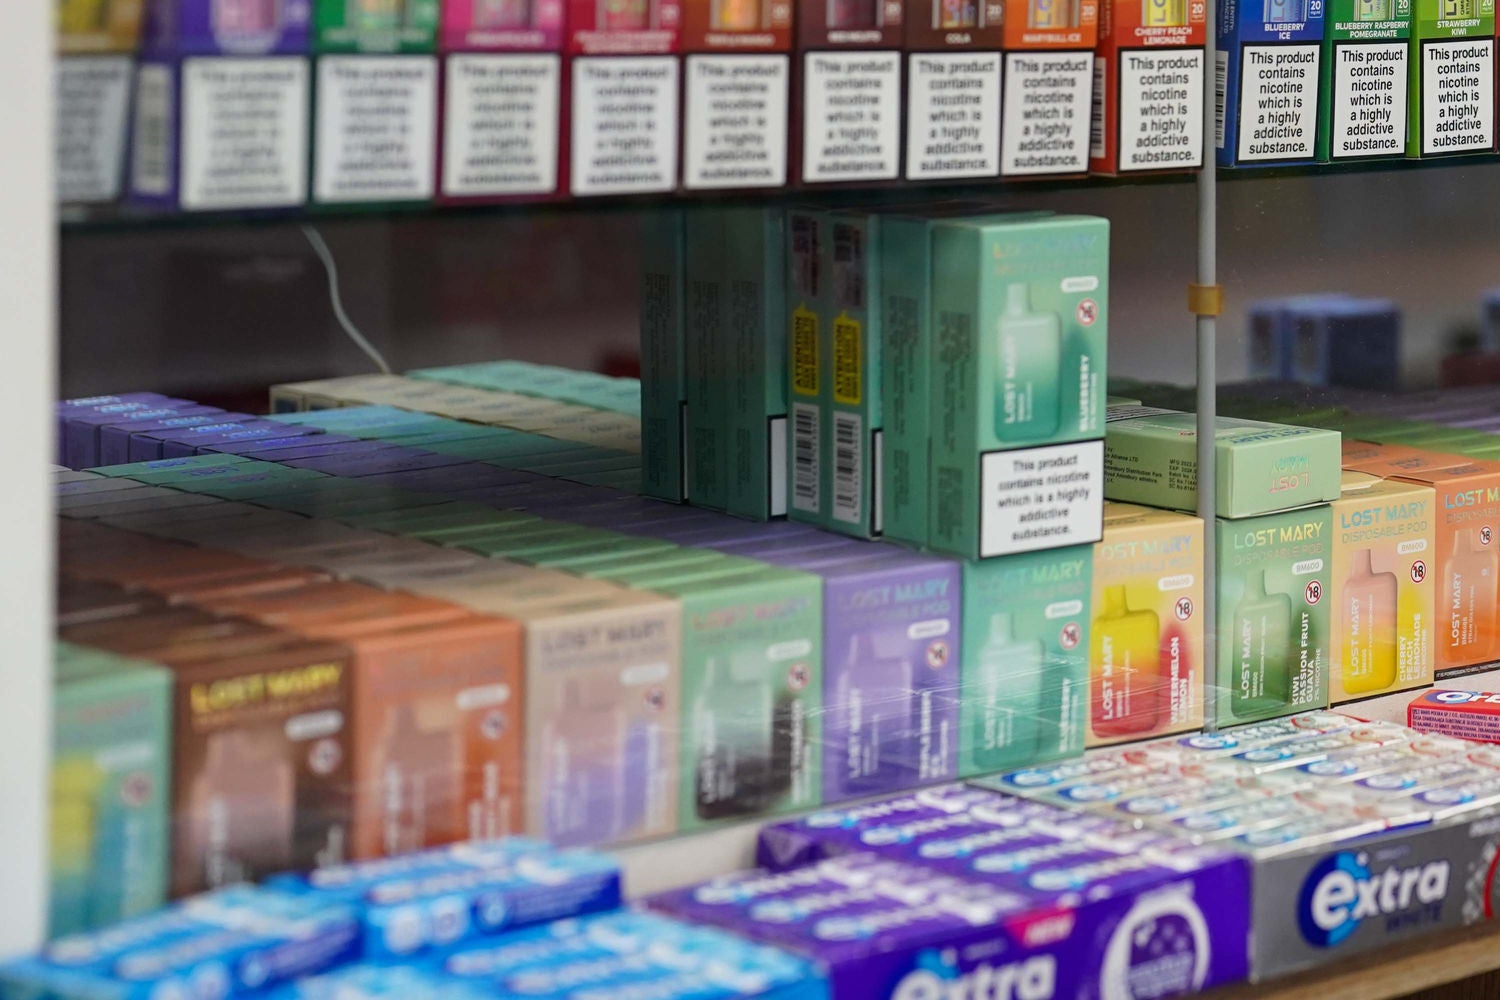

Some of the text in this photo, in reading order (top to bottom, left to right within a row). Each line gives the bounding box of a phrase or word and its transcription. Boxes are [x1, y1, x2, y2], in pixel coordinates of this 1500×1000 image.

[1264, 22, 1305, 32] BLUEBERRY
[1335, 21, 1409, 30] BLUEBERRY RASPBERRY
[1436, 18, 1481, 29] STRAWBERRY
[1451, 27, 1467, 36] KIWI
[1279, 31, 1291, 40] ICE
[1349, 30, 1398, 38] POMEGRANATE
[1249, 51, 1315, 67] This product
[1341, 49, 1403, 65] This product
[1258, 67, 1306, 80] contains
[1350, 64, 1395, 77] contains
[1259, 81, 1304, 95] nicotine
[1351, 79, 1393, 92] nicotine
[1258, 96, 1303, 109] which is
[1350, 93, 1393, 106] which is
[1258, 110, 1301, 127] a highly
[1350, 108, 1392, 124] a highly
[1253, 126, 1304, 140] addictive
[1346, 122, 1394, 136] addictive
[1248, 141, 1308, 155] substance.
[1342, 138, 1399, 151] substance.
[1079, 354, 1089, 433] BLUEBERRY
[1012, 455, 1078, 472] This product
[997, 471, 1090, 491] contains nicotine
[1269, 472, 1311, 494] LOST
[997, 487, 1090, 508] which is a highly
[1445, 488, 1485, 509] LOST
[1019, 508, 1069, 523] addictive
[1341, 500, 1428, 529] LOST MARY
[1011, 525, 1071, 541] substance.
[1234, 521, 1324, 550] LOST MARY
[1342, 520, 1428, 545] DISPOSABLE POD
[1142, 534, 1193, 556] MARY
[1451, 572, 1462, 647] LOST MARY
[1351, 597, 1361, 676] LOST MARY
[1413, 612, 1421, 680] LEMONADE
[1241, 618, 1252, 700] LOST MARY
[1299, 612, 1310, 704] PASSION FRUIT
[1399, 635, 1407, 682] CHERRY
[1102, 635, 1113, 720] LOST MARY
[1170, 636, 1180, 725] WATERMELON
[1306, 659, 1315, 703] GUAVA
[1291, 675, 1300, 706] KIWI
[1179, 677, 1188, 723] LEMON
[1311, 860, 1450, 931] extra
